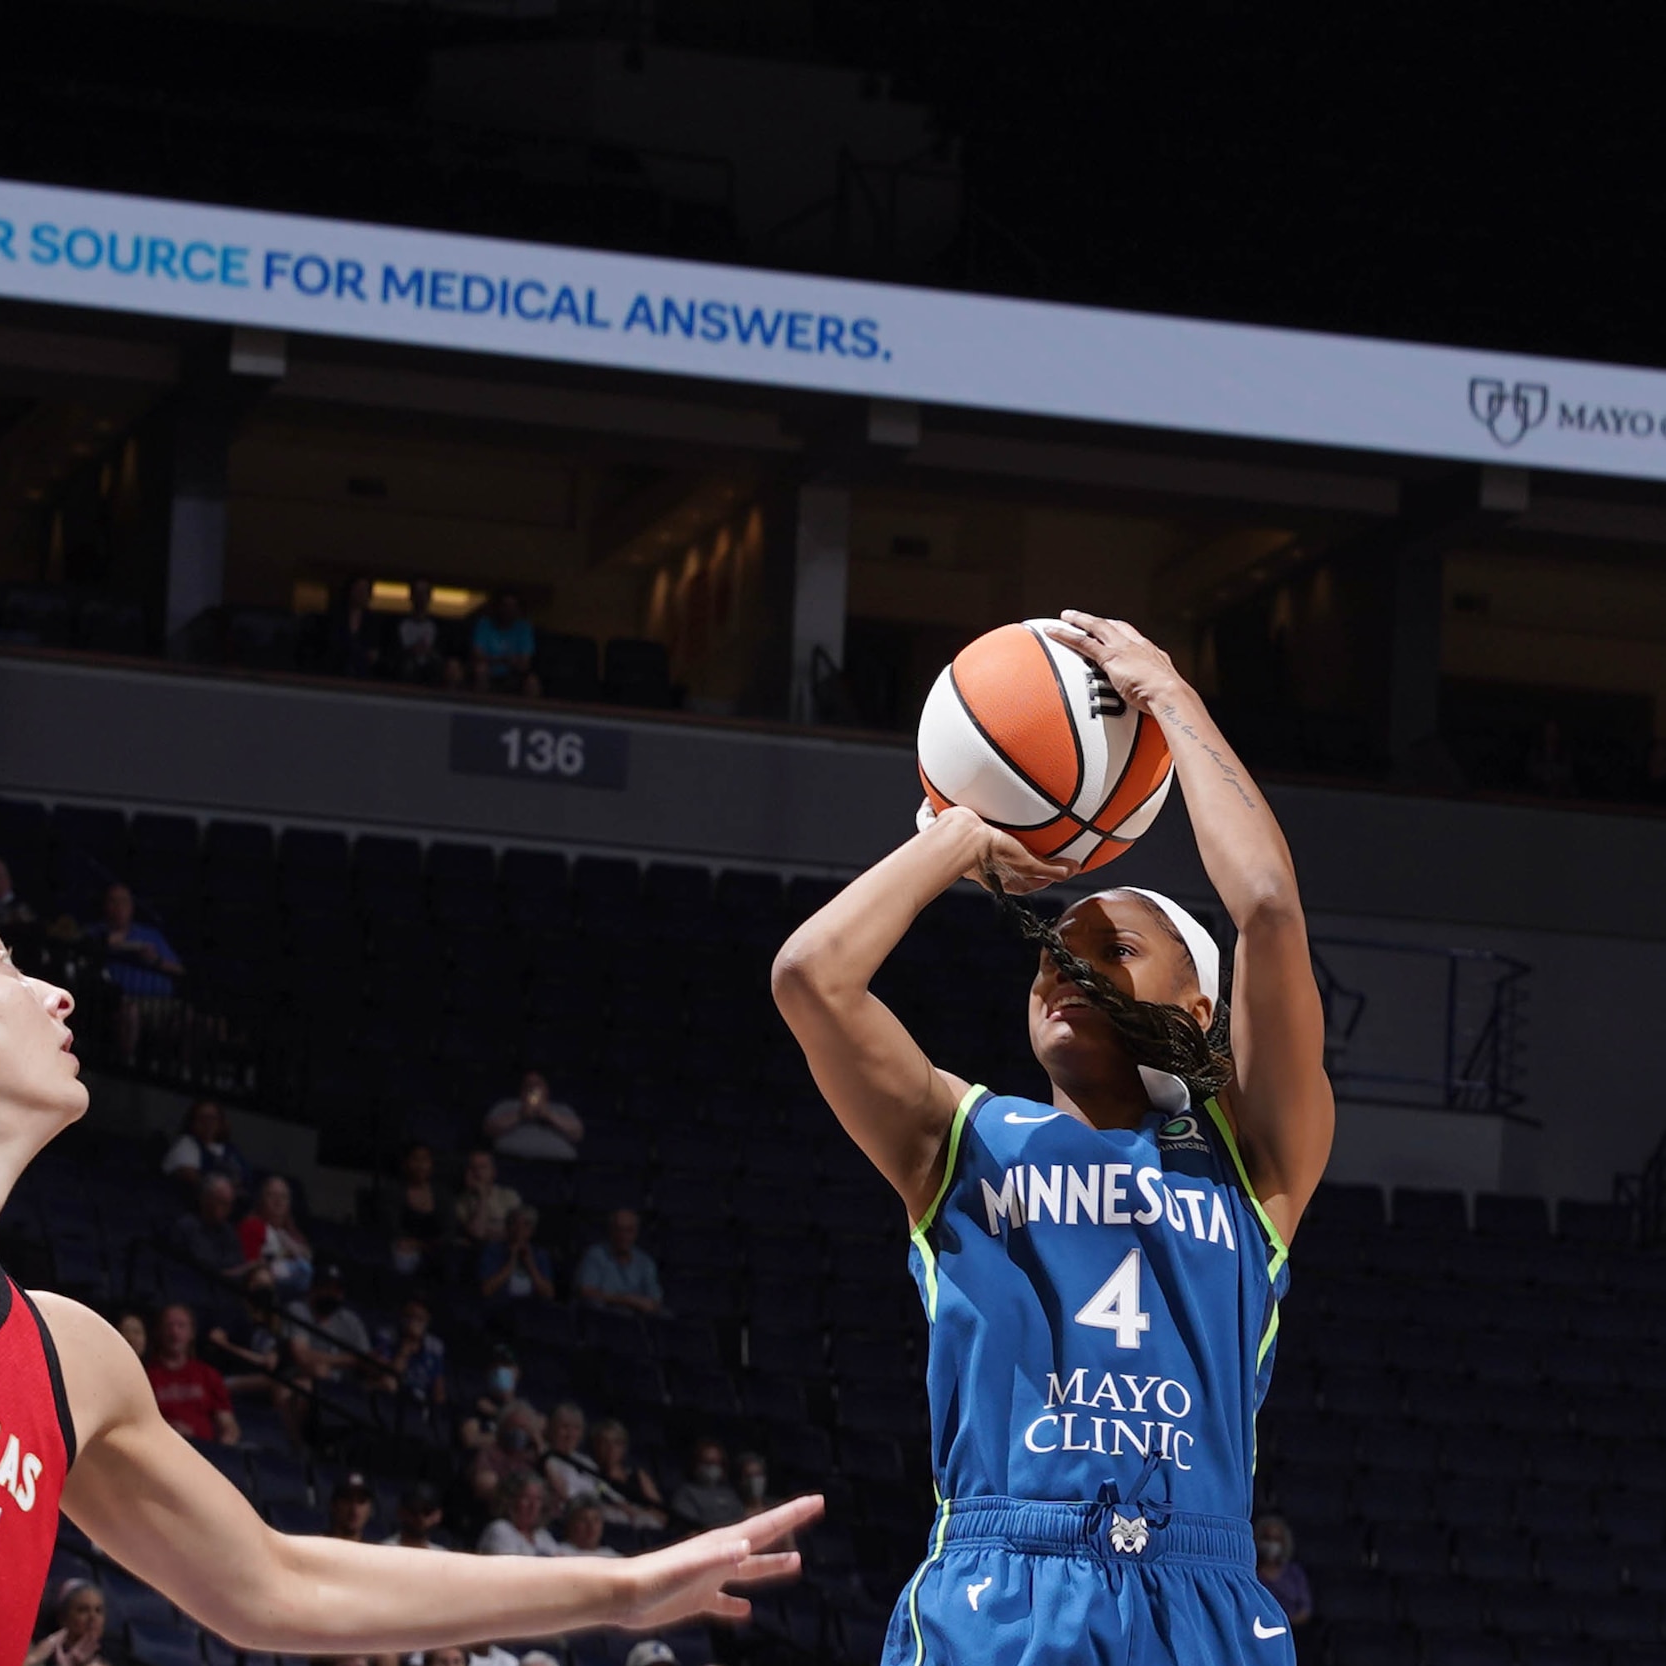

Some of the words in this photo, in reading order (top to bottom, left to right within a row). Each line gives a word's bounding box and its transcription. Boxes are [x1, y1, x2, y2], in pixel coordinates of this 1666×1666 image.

[28, 220, 251, 289] SOURCE
[262, 250, 368, 304] FOR
[378, 263, 612, 331] MEDICAL
[621, 291, 893, 364] ANSWERS.
[1557, 402, 1657, 438] MAYO
[498, 729, 585, 776] 136
[979, 1162, 1236, 1253] MINNESOTA
[1074, 1247, 1151, 1350] 4
[1043, 1367, 1192, 1418] MAYO
[1024, 1413, 1196, 1472] CLINIC
